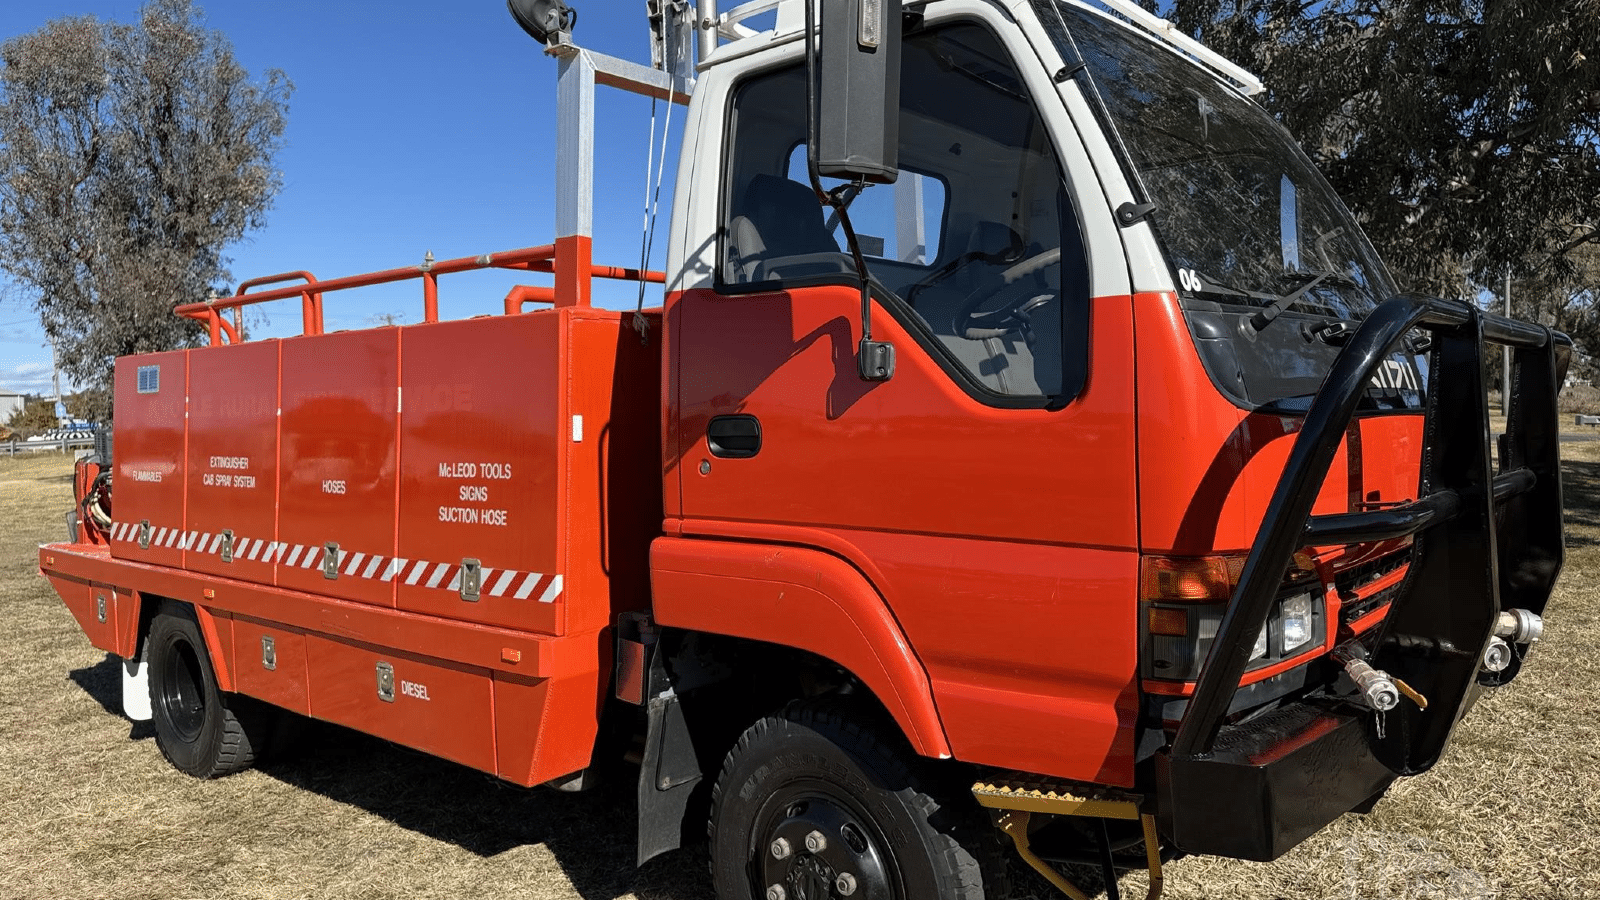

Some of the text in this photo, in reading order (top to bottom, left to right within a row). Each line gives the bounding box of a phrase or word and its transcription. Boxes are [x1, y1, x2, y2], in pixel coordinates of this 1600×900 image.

[1178, 268, 1202, 292] 06
[209, 455, 249, 470] EXTINGUISHER
[132, 470, 162, 483] FLAMMABLES
[479, 463, 512, 480] TOOLS
[202, 473, 256, 488] CAB SPRAY SYSTEM
[322, 479, 346, 495] HOSES
[459, 485, 488, 502] SIGNS
[438, 506, 508, 526] SUCTION HOSE
[400, 679, 431, 701] DIESEL
